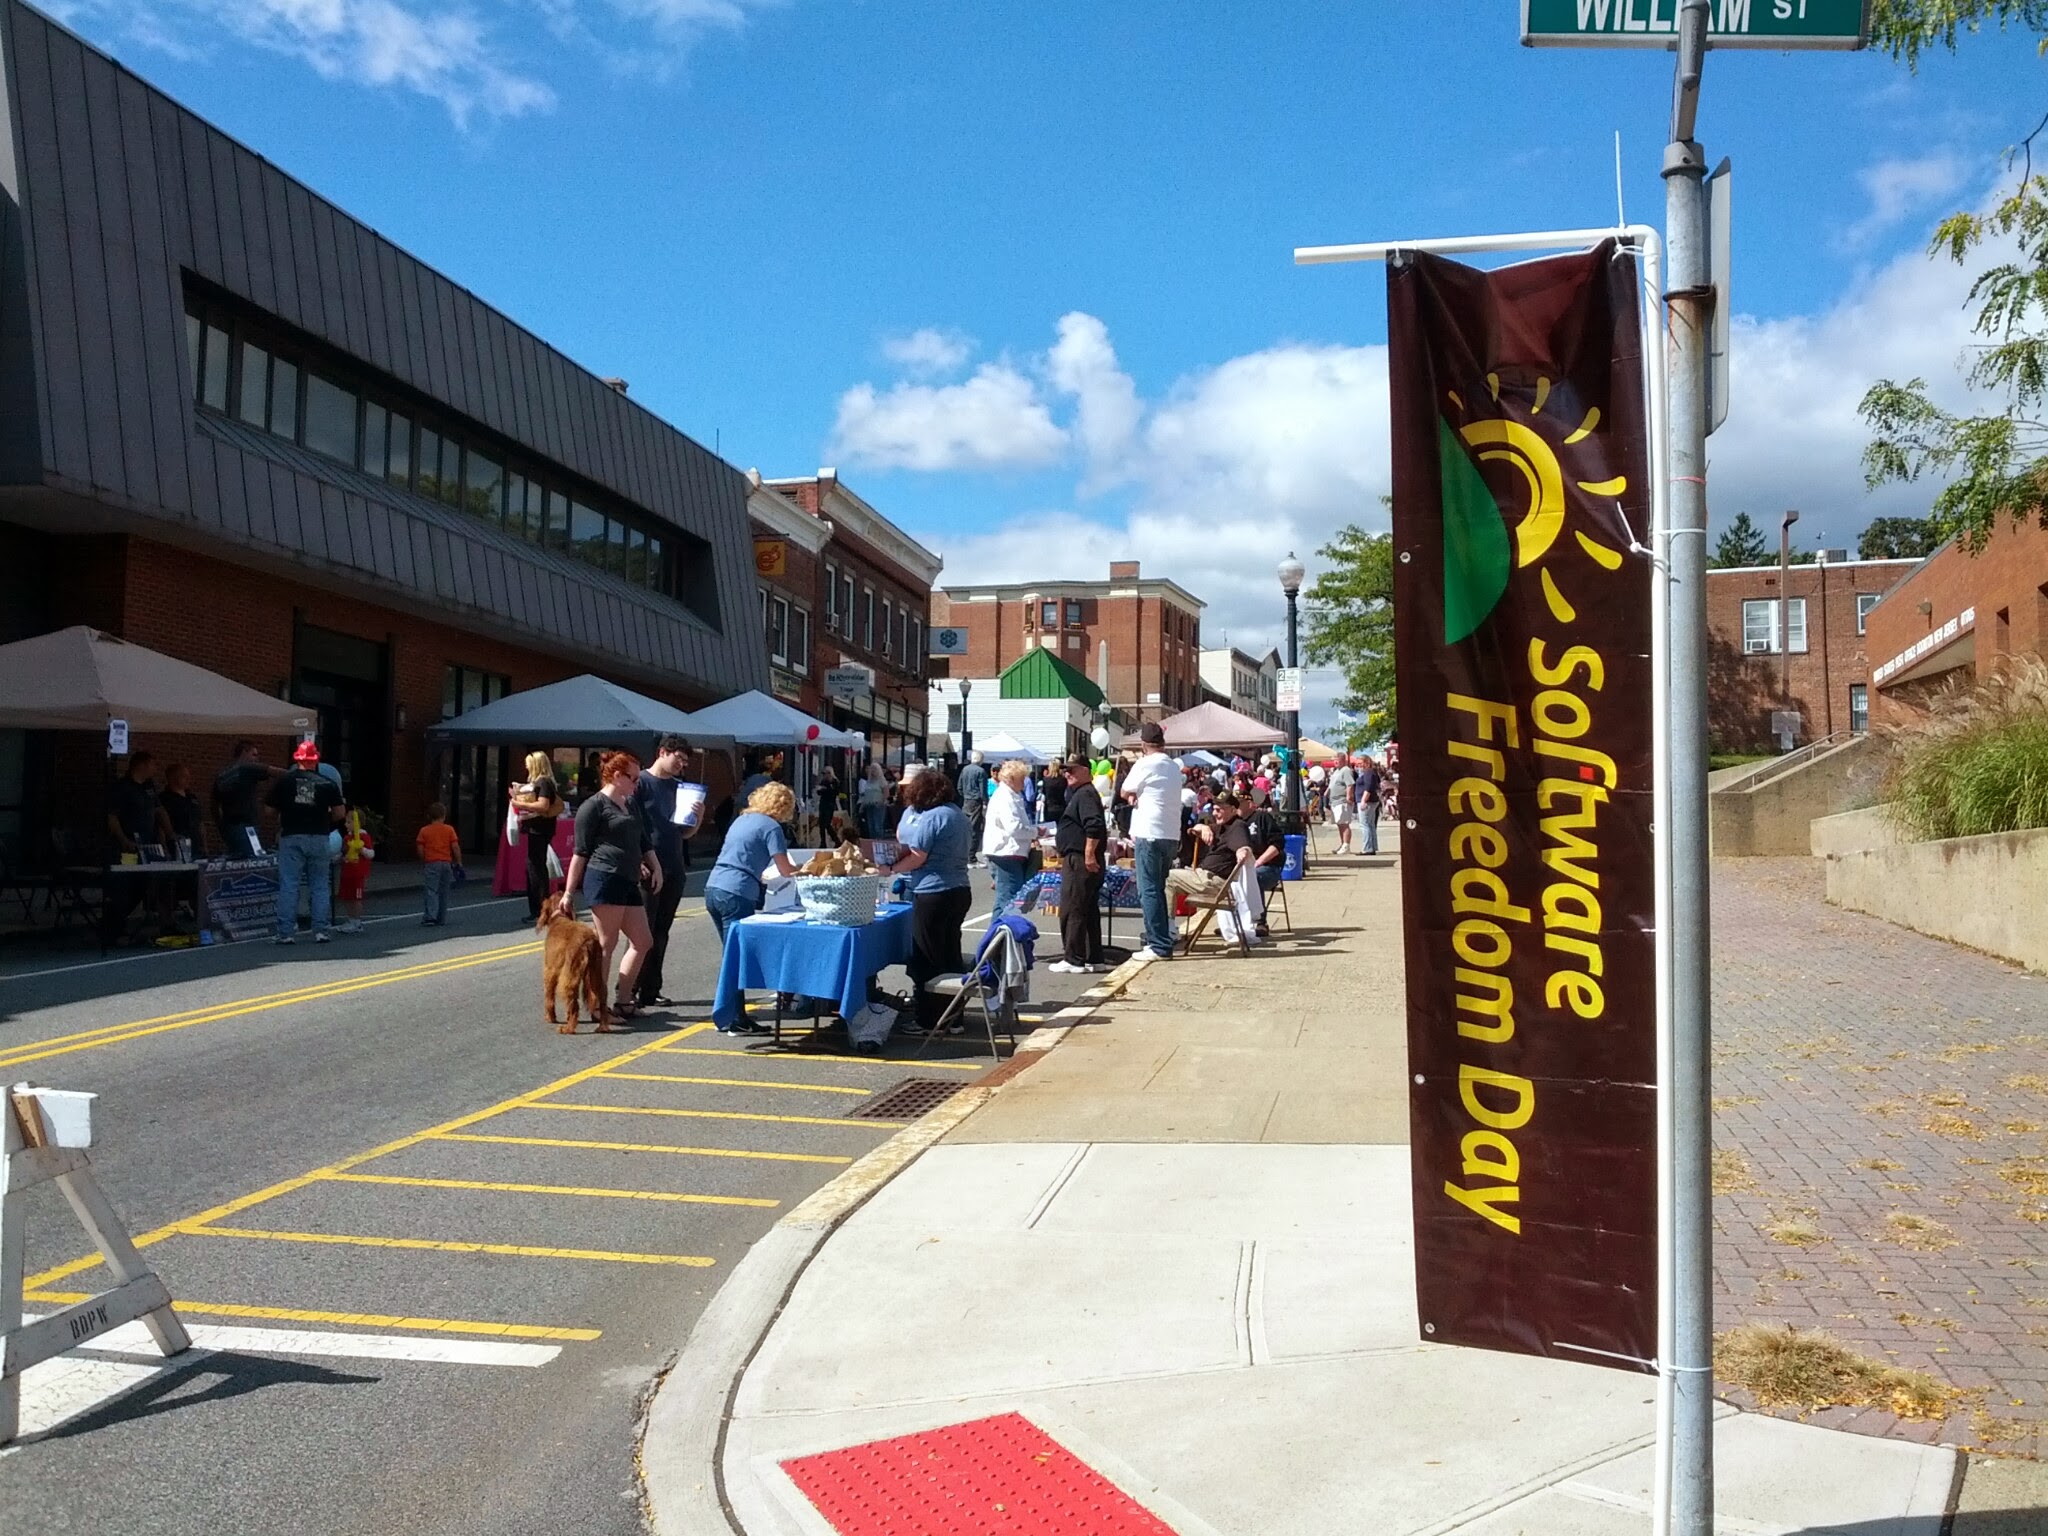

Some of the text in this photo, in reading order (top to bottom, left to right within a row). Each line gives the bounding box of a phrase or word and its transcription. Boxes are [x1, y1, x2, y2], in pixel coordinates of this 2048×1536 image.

[1576, 0, 1751, 33] WILLIM
[1444, 691, 1535, 1235] Freedom Day
[1527, 636, 1618, 1019] Software
